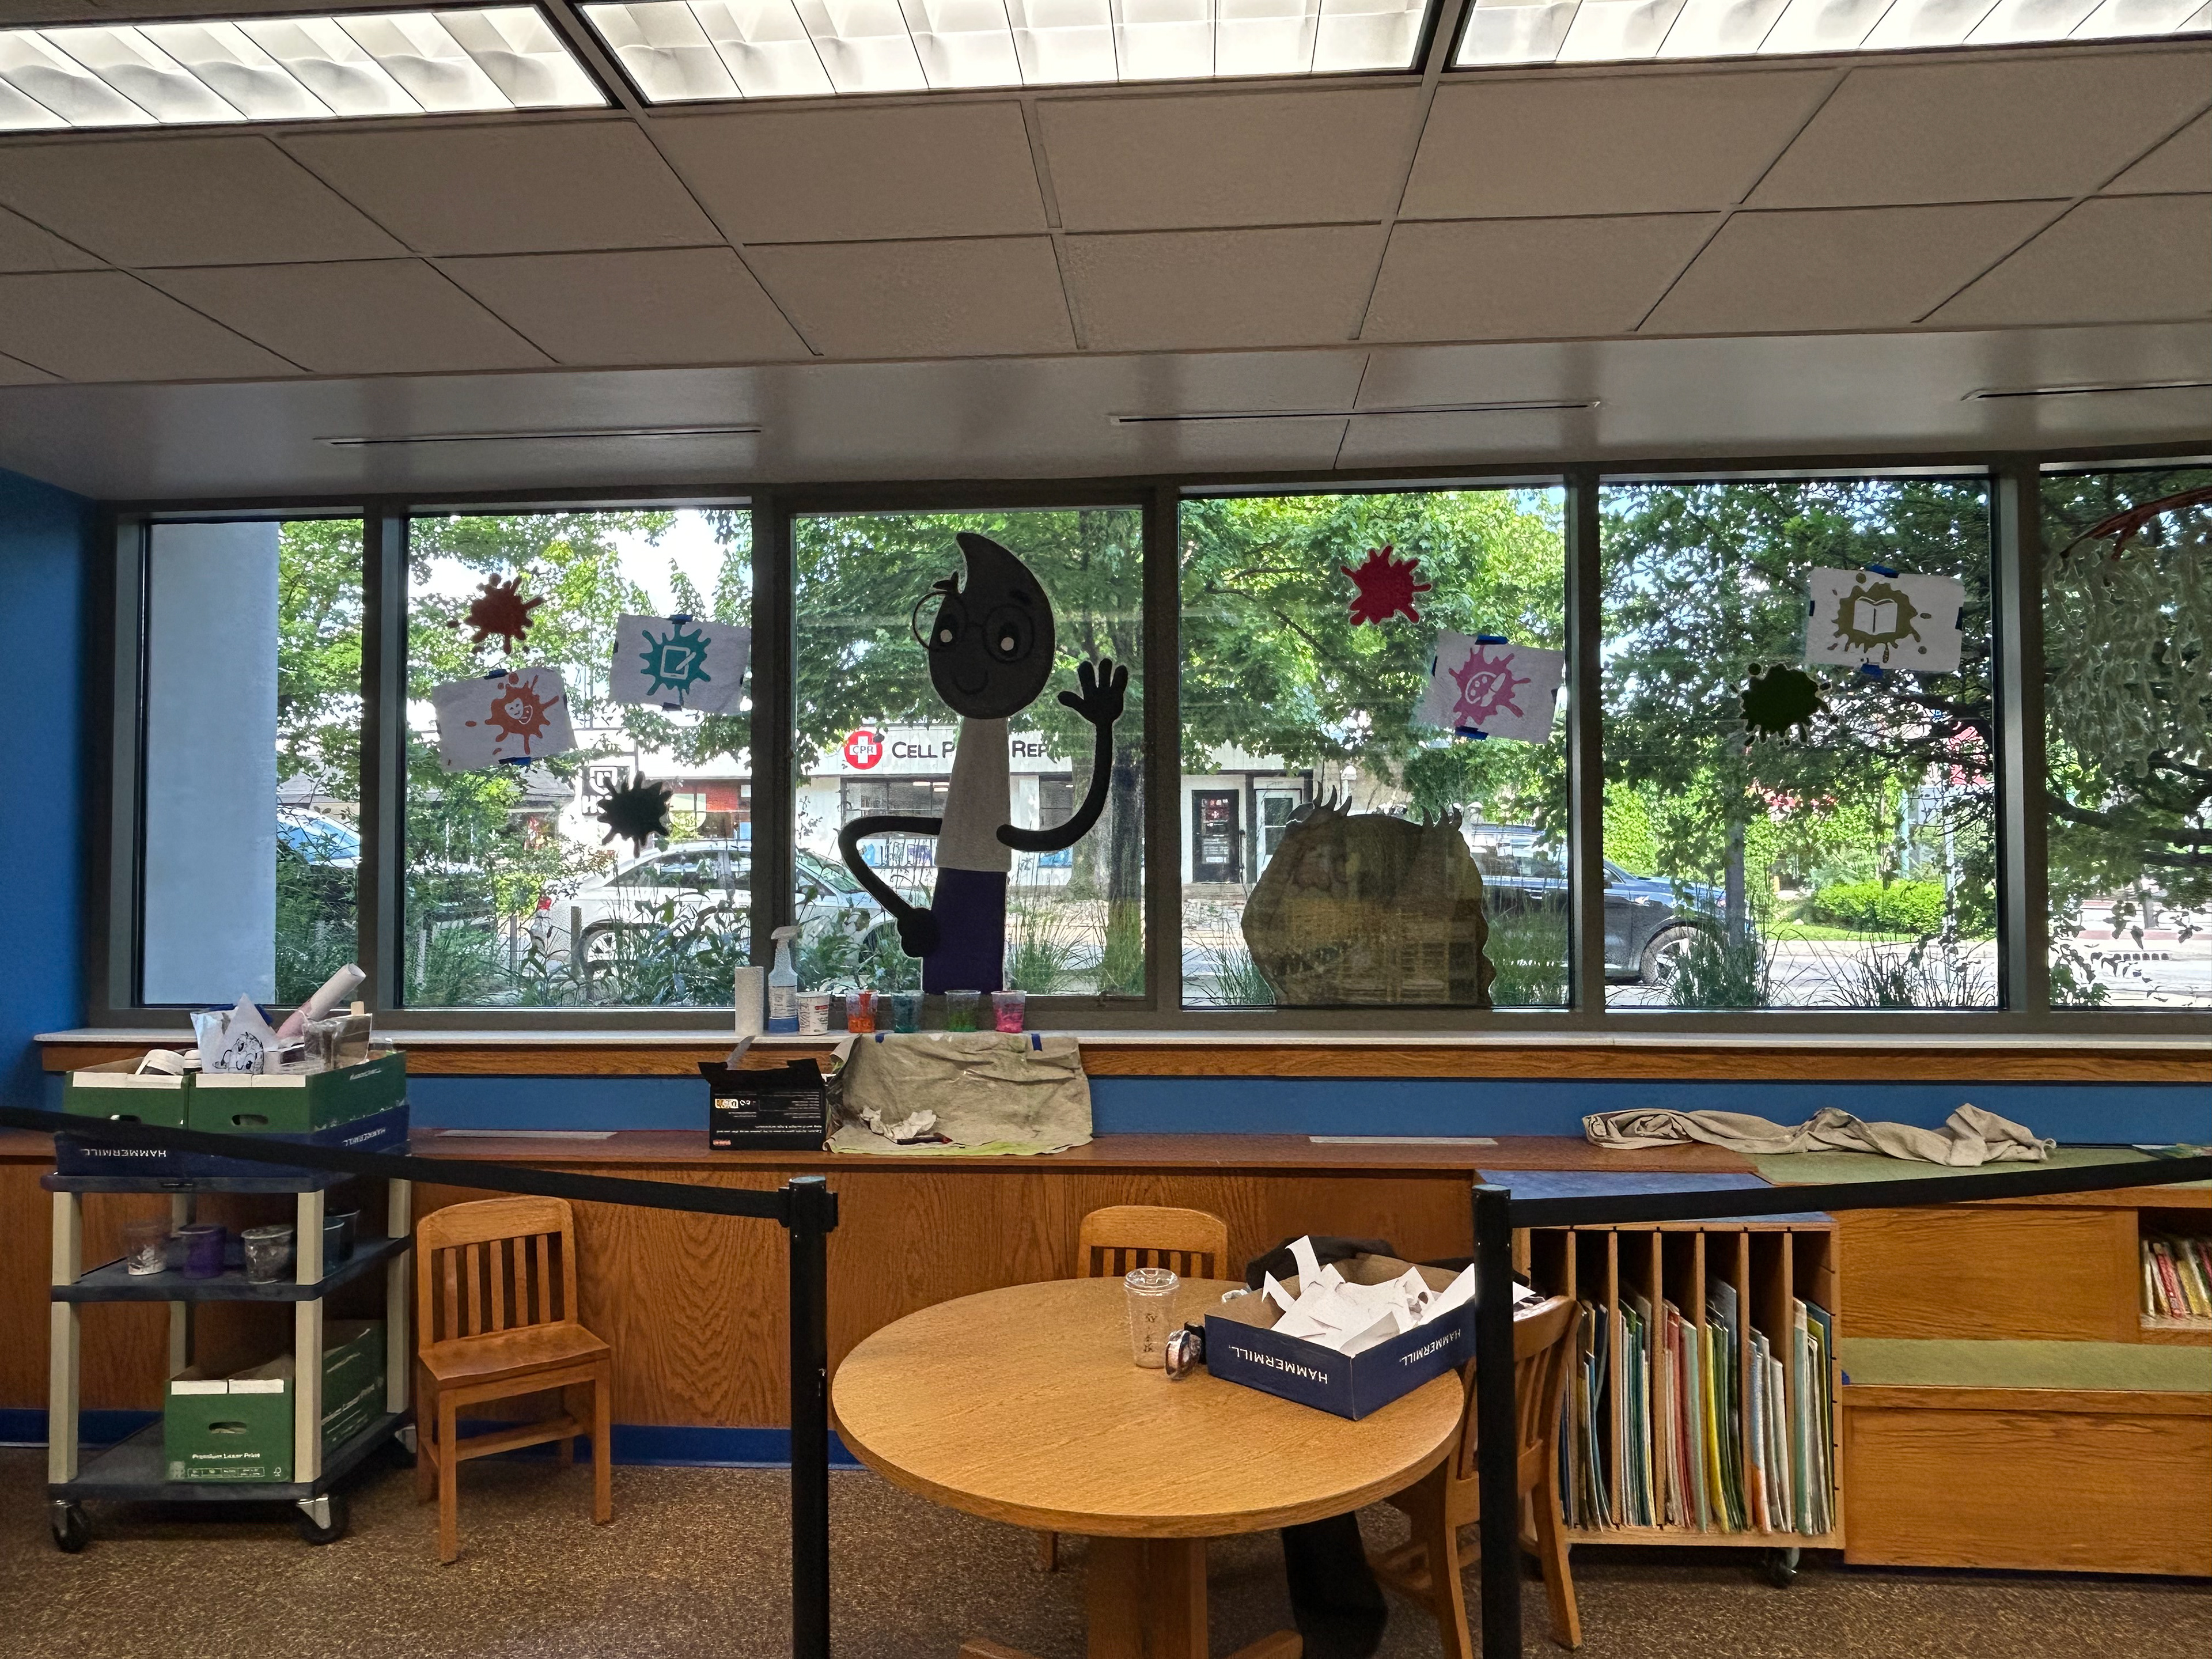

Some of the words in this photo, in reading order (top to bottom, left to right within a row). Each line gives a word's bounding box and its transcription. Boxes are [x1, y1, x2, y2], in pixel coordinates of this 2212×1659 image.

[853, 745, 873, 754] CPR
[893, 741, 938, 758] CELL
[1012, 740, 1048, 757] REP
[79, 1149, 167, 1158] HAMMERMILL
[1401, 1329, 1461, 1366] HAMMERMILL
[1231, 1346, 1328, 1384] HAMMERMILL
